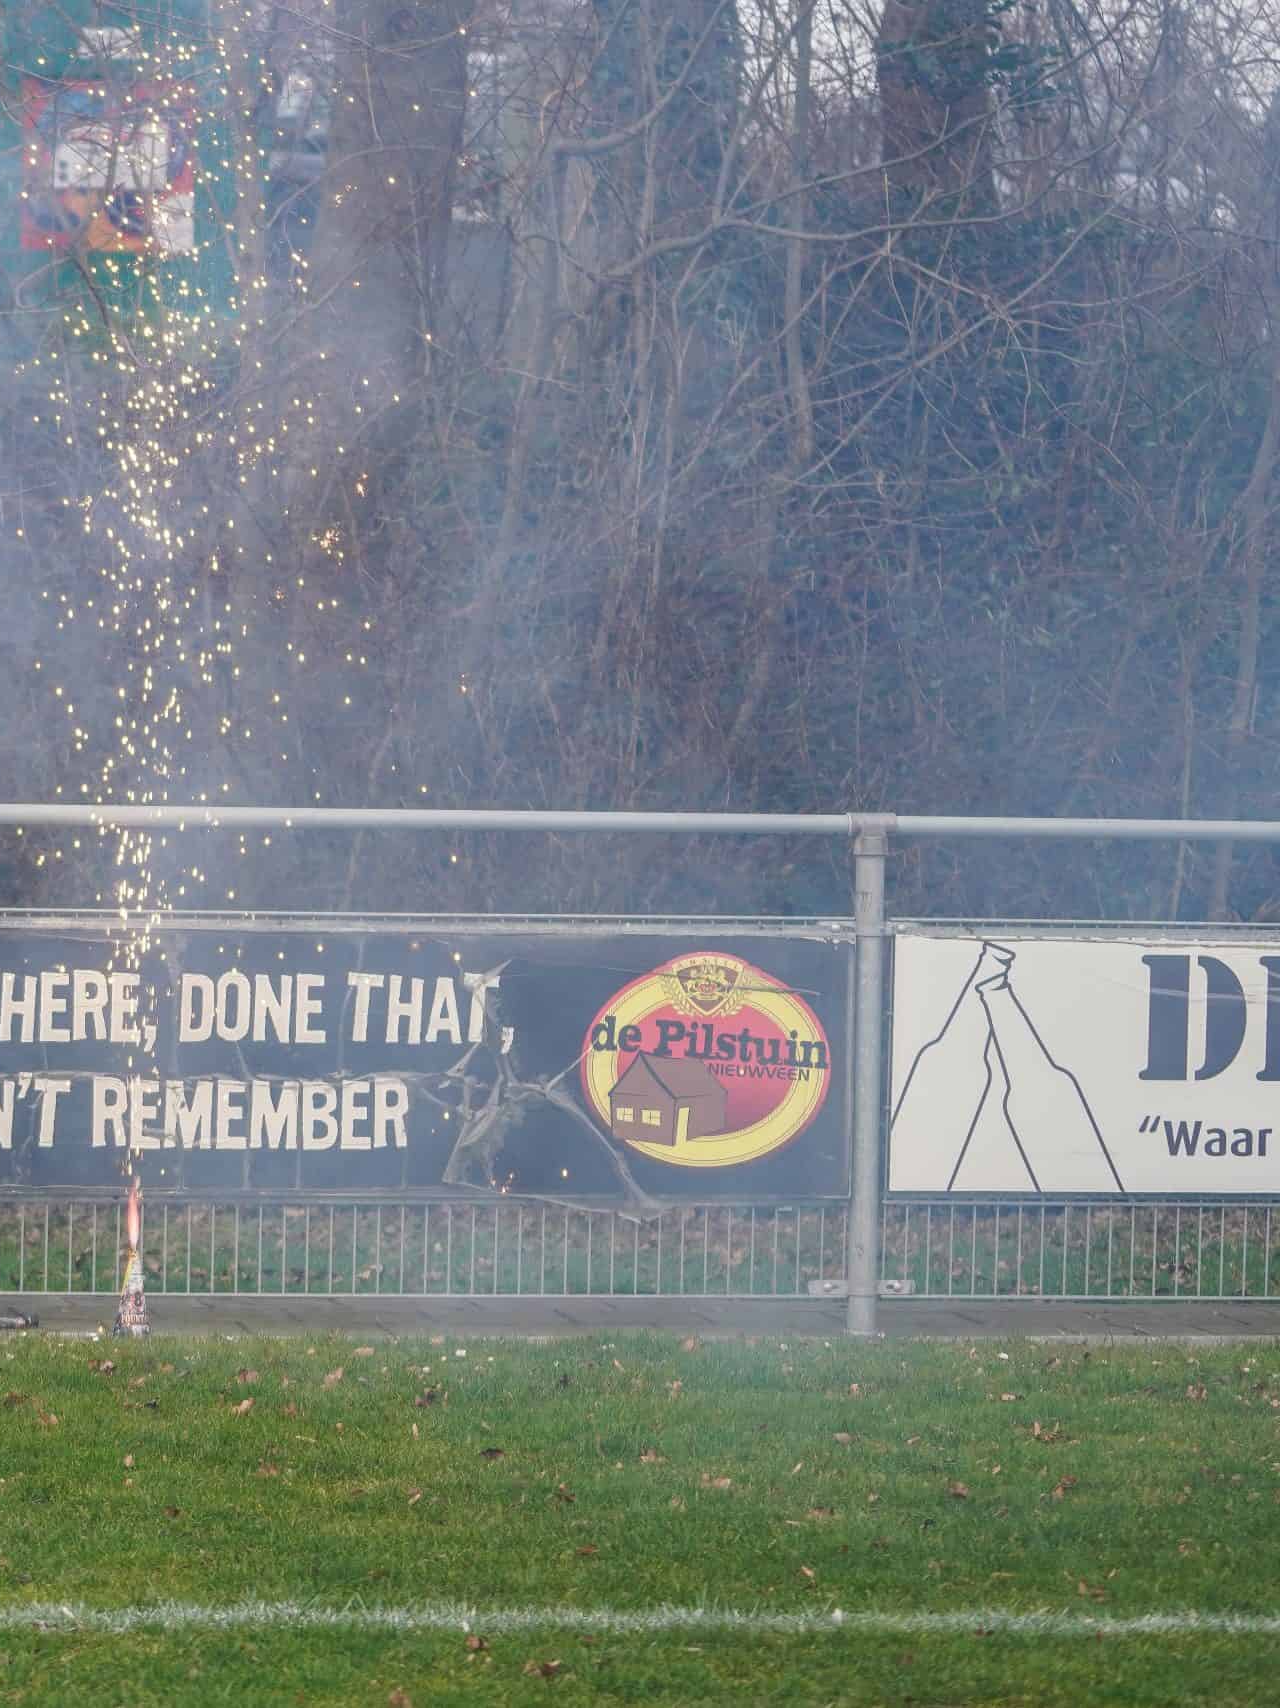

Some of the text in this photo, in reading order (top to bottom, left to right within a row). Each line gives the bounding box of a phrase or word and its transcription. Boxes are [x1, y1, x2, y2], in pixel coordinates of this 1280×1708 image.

[179, 972, 328, 1043] DONE
[347, 972, 514, 1054] THAT,
[591, 1015, 829, 1069] de Pilstuin
[1139, 954, 1280, 1081] D
[707, 1062, 810, 1081] NIEUWVEEN
[92, 1076, 409, 1150] REMEMBER
